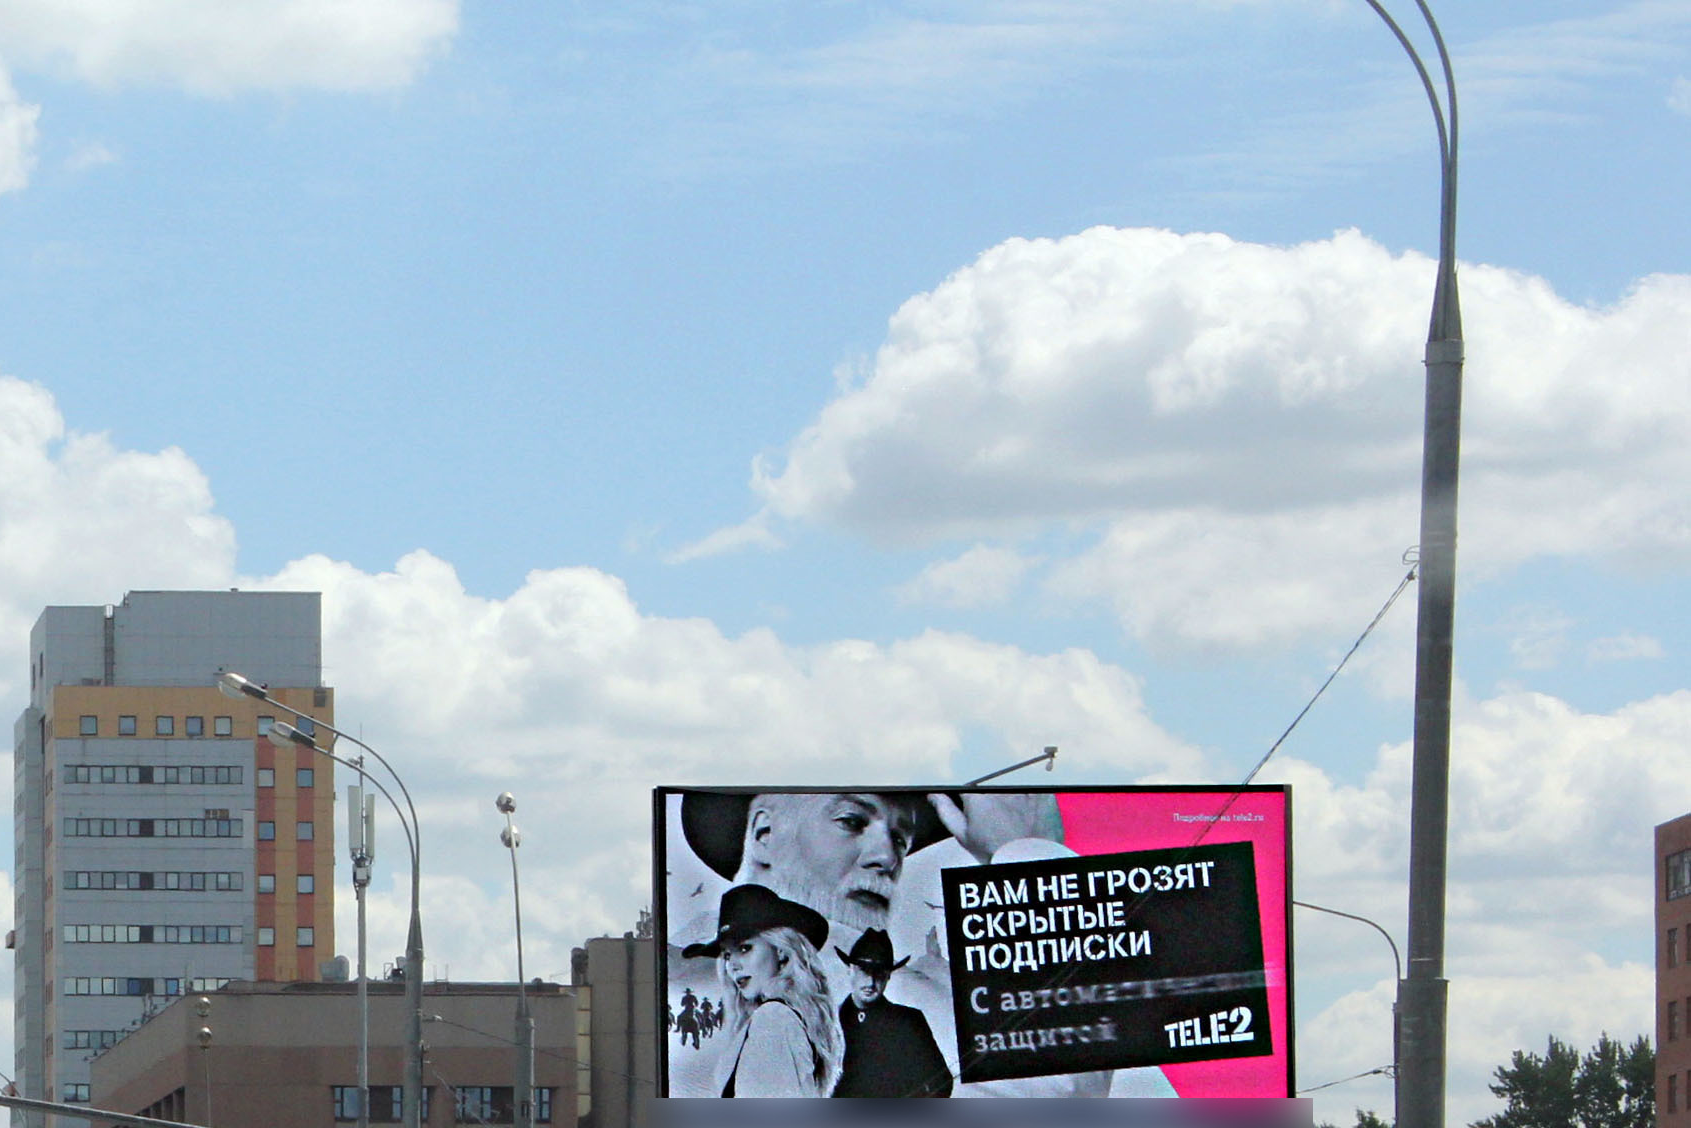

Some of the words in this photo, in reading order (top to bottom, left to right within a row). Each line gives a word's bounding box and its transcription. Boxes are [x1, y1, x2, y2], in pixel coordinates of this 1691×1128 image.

[959, 878, 1029, 909] ВАМ
[1036, 873, 1080, 902] НЕ
[1087, 861, 1215, 897] ГРОЗЯТ
[962, 901, 1126, 940] СКРЫТЫЕ
[965, 930, 1151, 973] ПОДПИСКИ
[1163, 1006, 1255, 1048] TELE2
